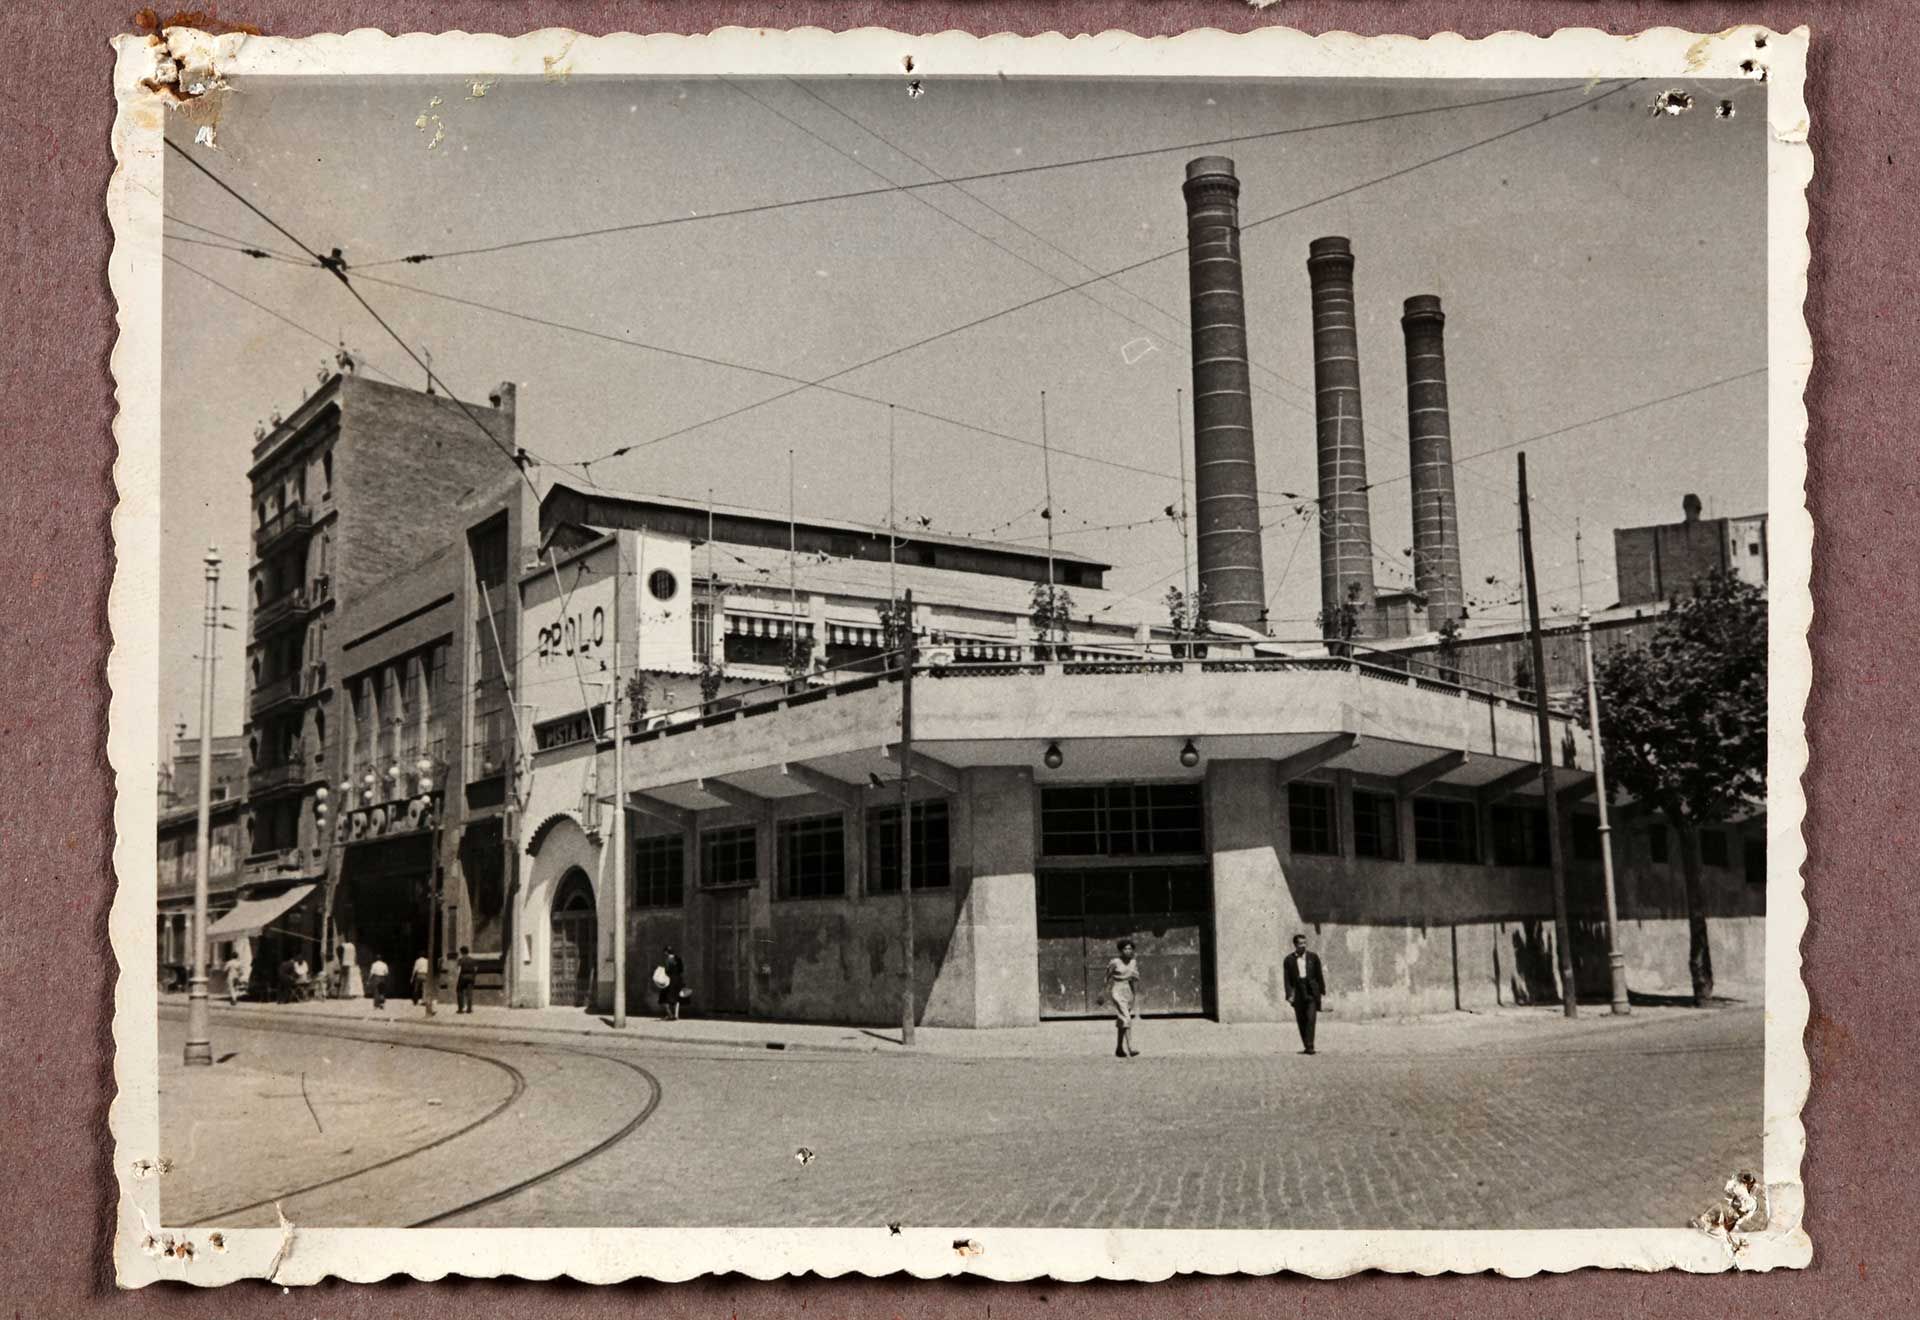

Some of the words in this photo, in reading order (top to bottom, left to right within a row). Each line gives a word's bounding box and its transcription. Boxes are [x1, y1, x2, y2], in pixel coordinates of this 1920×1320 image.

[538, 606, 604, 660] APOLO
[547, 720, 579, 749] PISTA
[333, 799, 426, 844] APOLO
